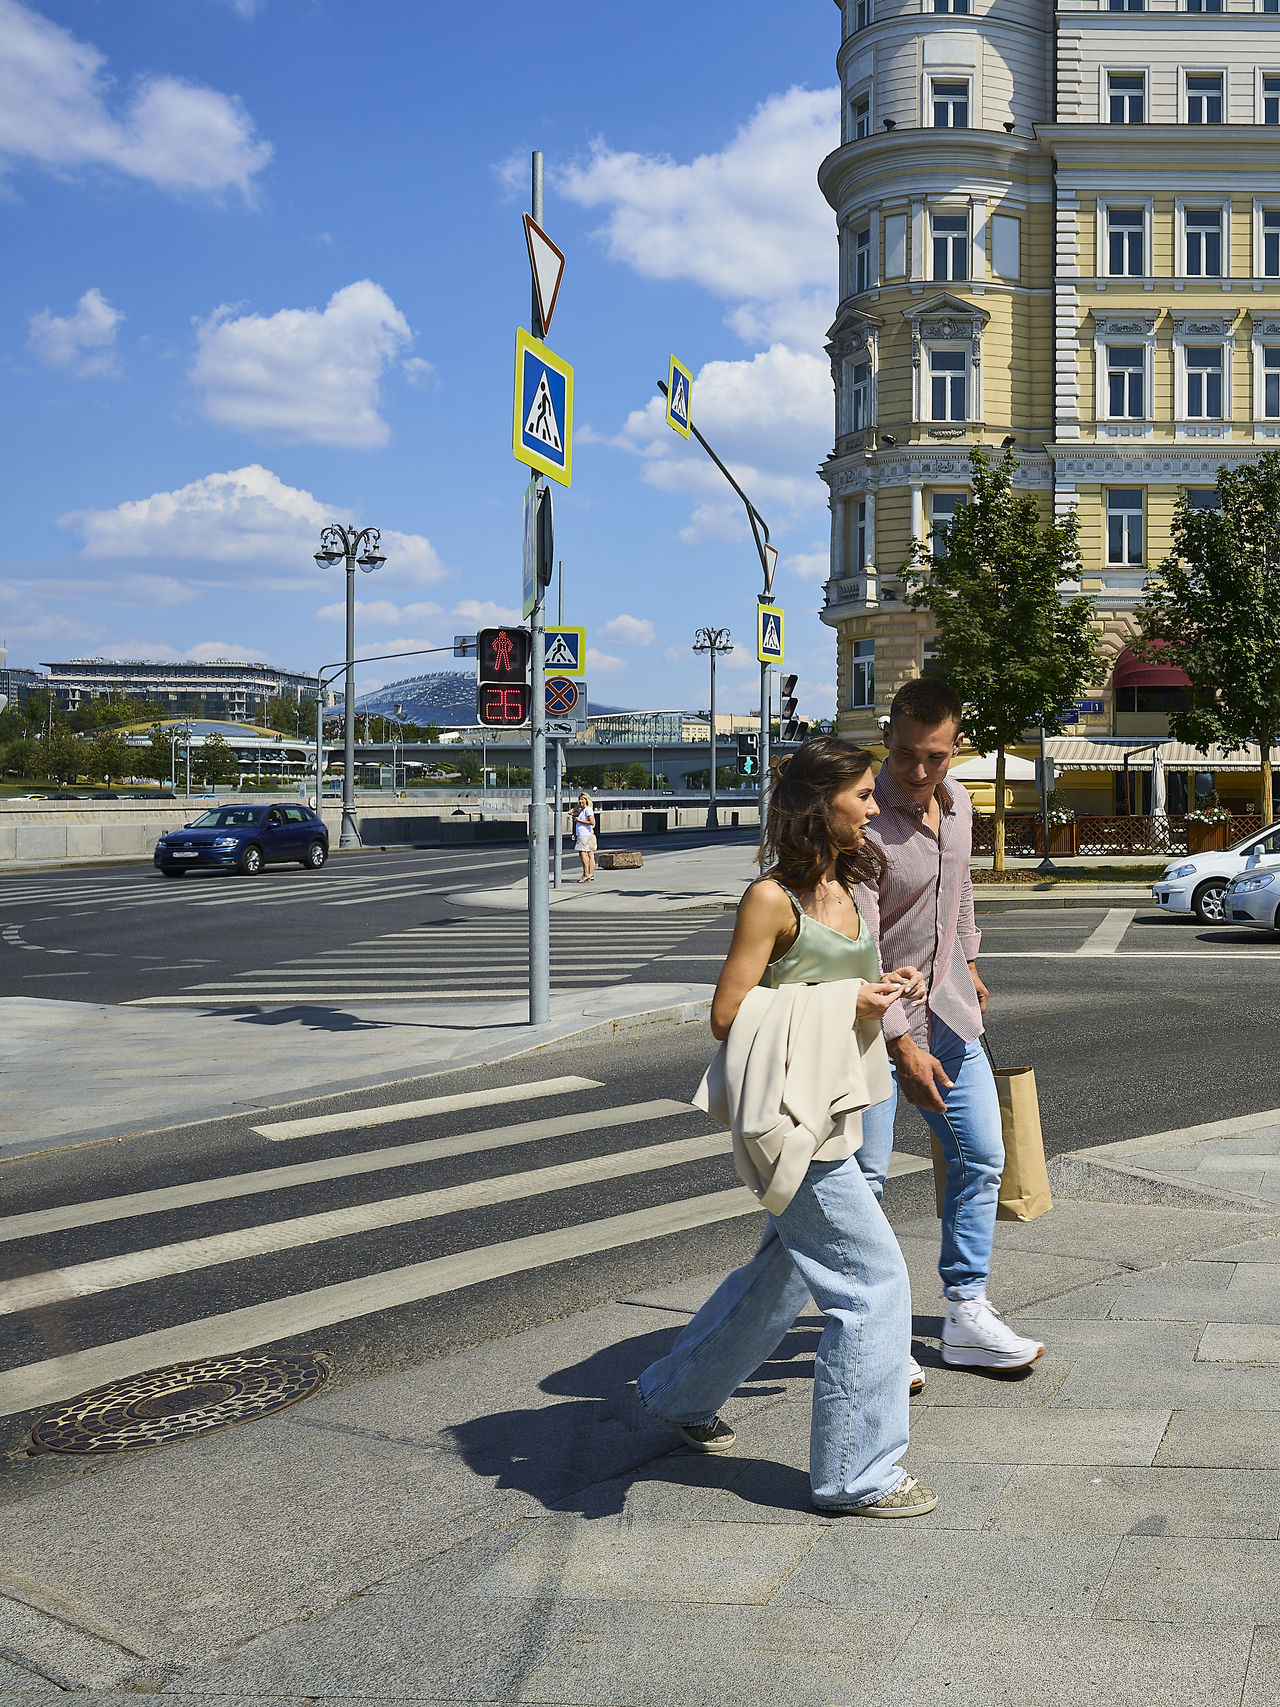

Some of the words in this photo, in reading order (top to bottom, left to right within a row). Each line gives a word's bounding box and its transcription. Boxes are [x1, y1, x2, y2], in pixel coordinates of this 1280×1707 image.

[486, 689, 522, 719] 26
[1094, 703, 1099, 711] 1
[747, 735, 756, 749] 4
